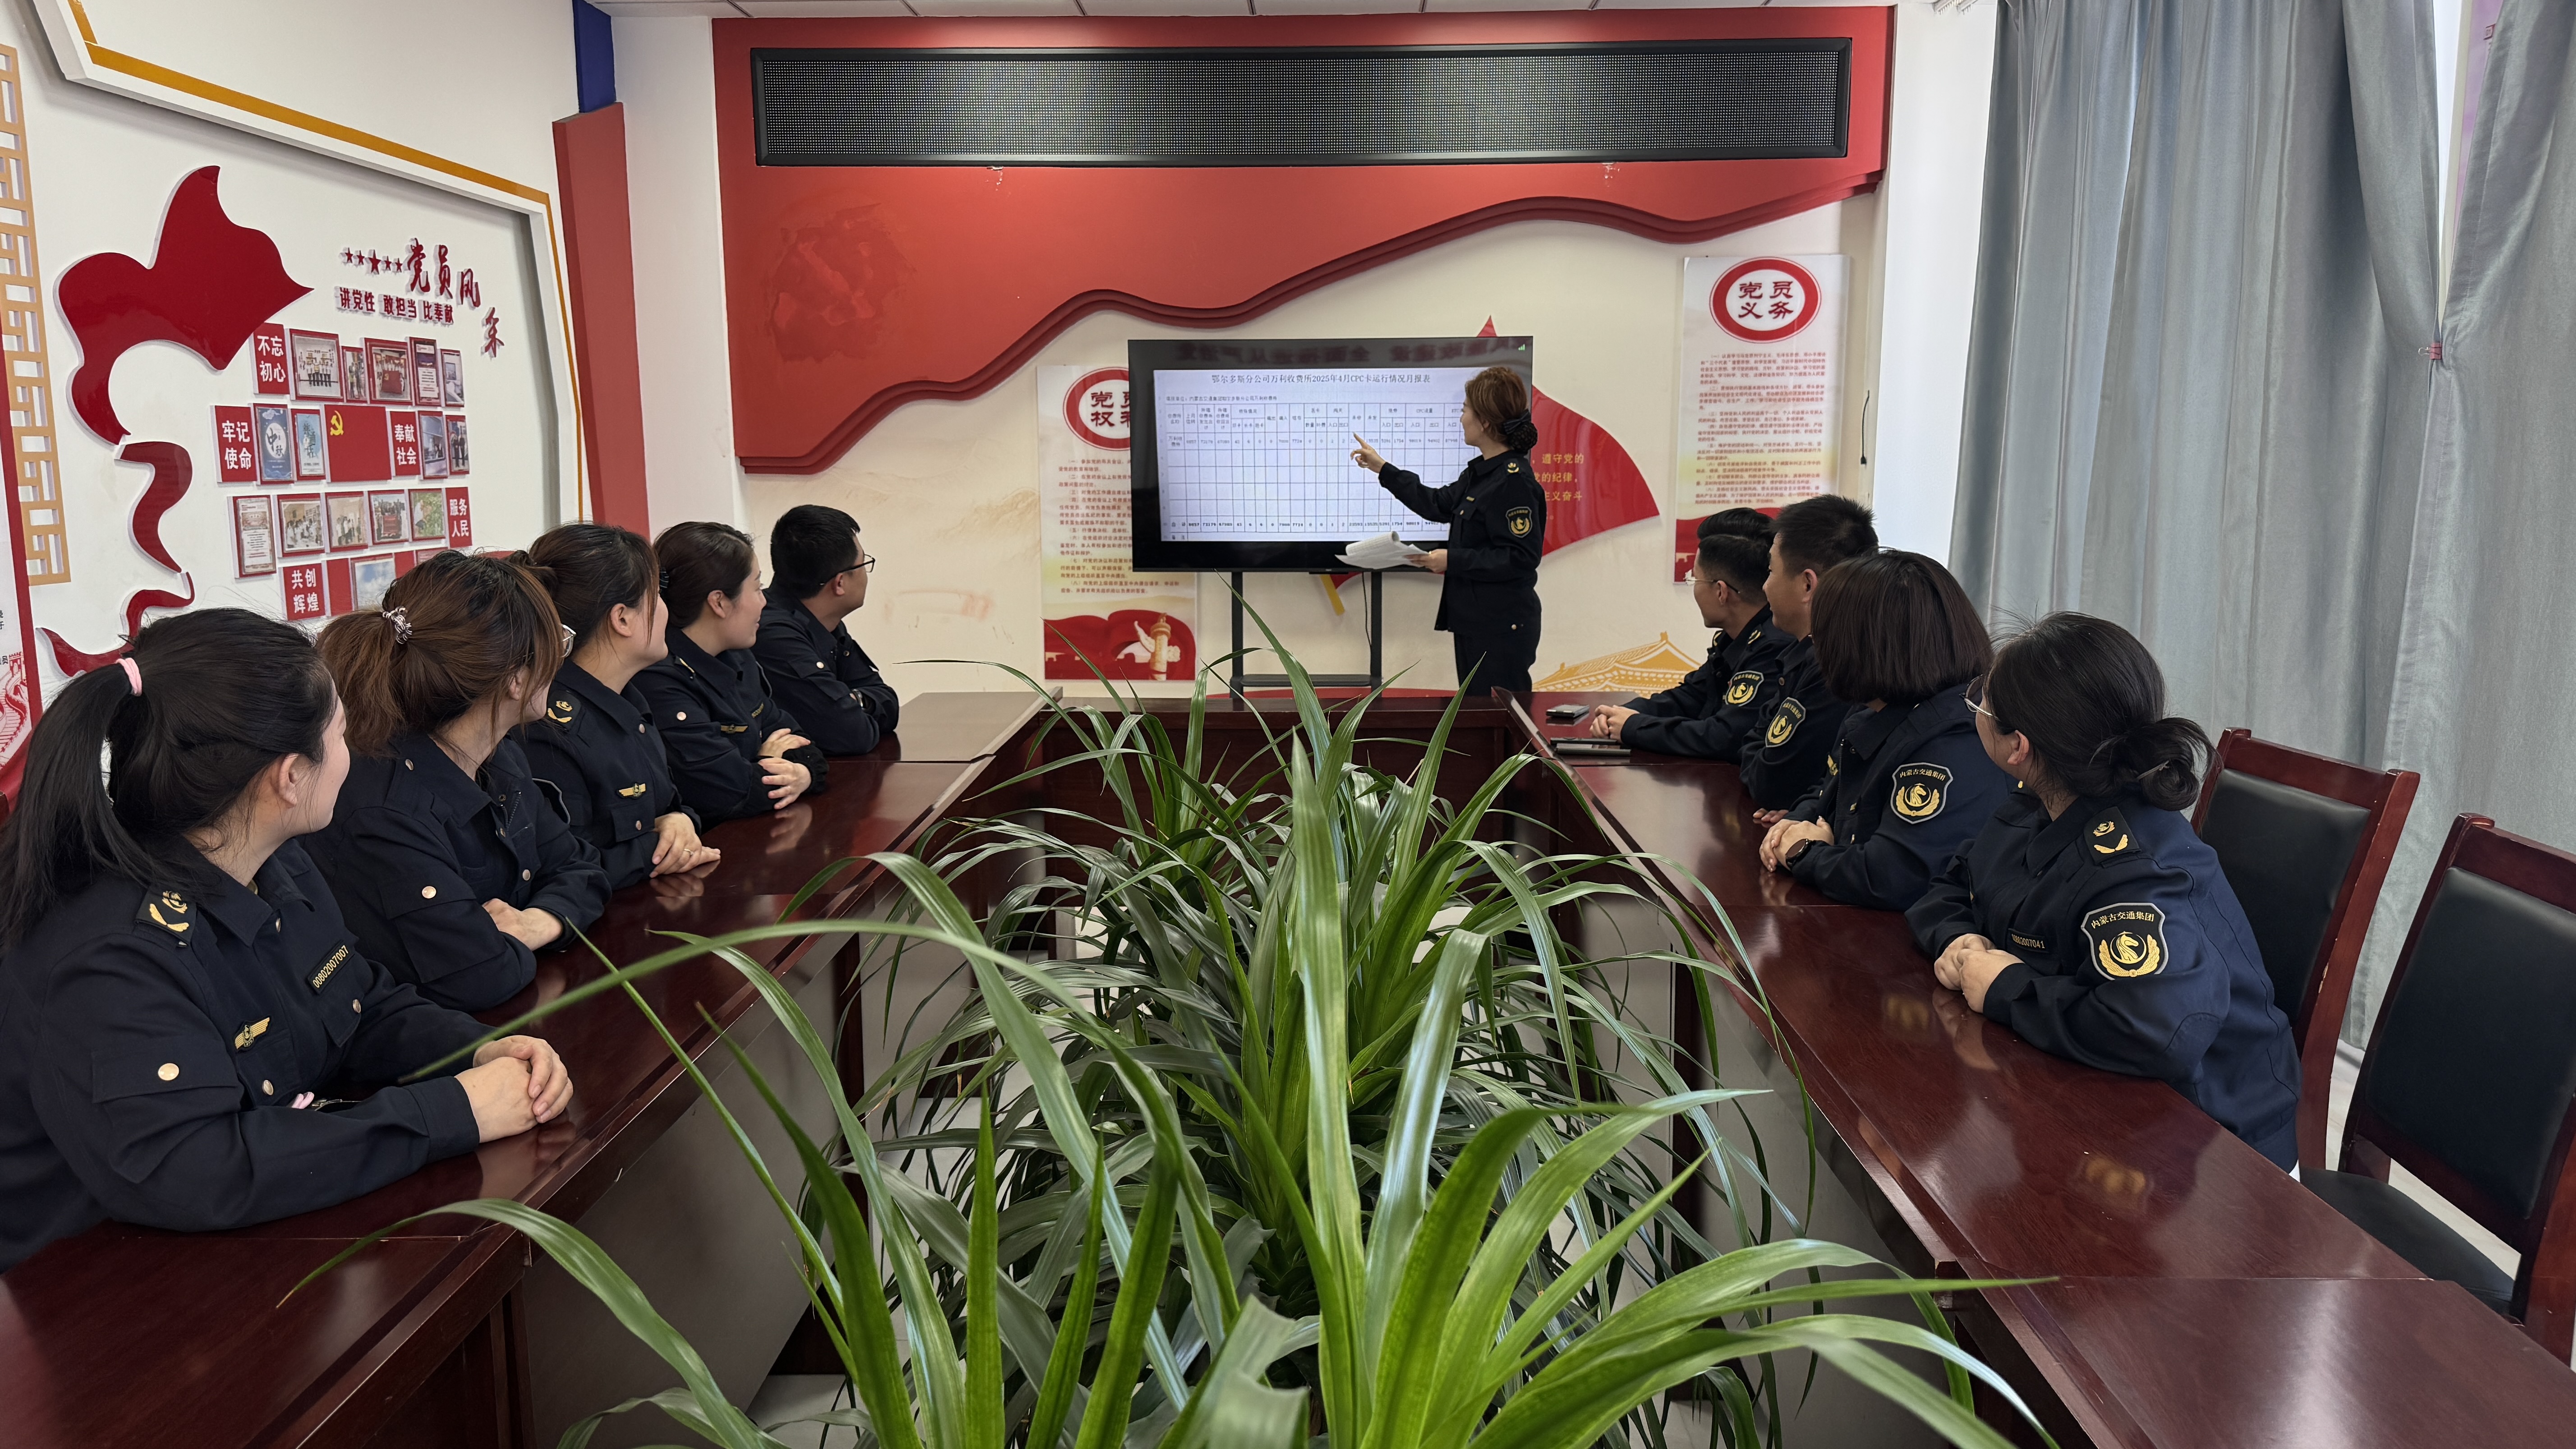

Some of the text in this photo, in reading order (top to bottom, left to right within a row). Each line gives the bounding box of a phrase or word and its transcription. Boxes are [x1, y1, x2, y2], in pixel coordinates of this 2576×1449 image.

[1738, 281, 1794, 299] 党员
[340, 287, 454, 324] 讲党性 敢担当 比奉献
[1738, 301, 1794, 319] 义务
[257, 336, 284, 357] 不忘
[259, 360, 286, 382] 初心
[222, 420, 250, 443] 牢记
[394, 424, 415, 442] 奉献
[225, 447, 252, 469] 使命
[396, 446, 417, 465] 社会
[450, 498, 467, 516] 服务
[452, 520, 469, 538] 人民
[291, 568, 317, 589] 共创
[294, 592, 319, 614] 辉煌
[1900, 768, 1946, 782] 内蒙古交通集团
[2091, 911, 2155, 929] 内蒙古交通集团
[313, 945, 349, 988] 00802007007
